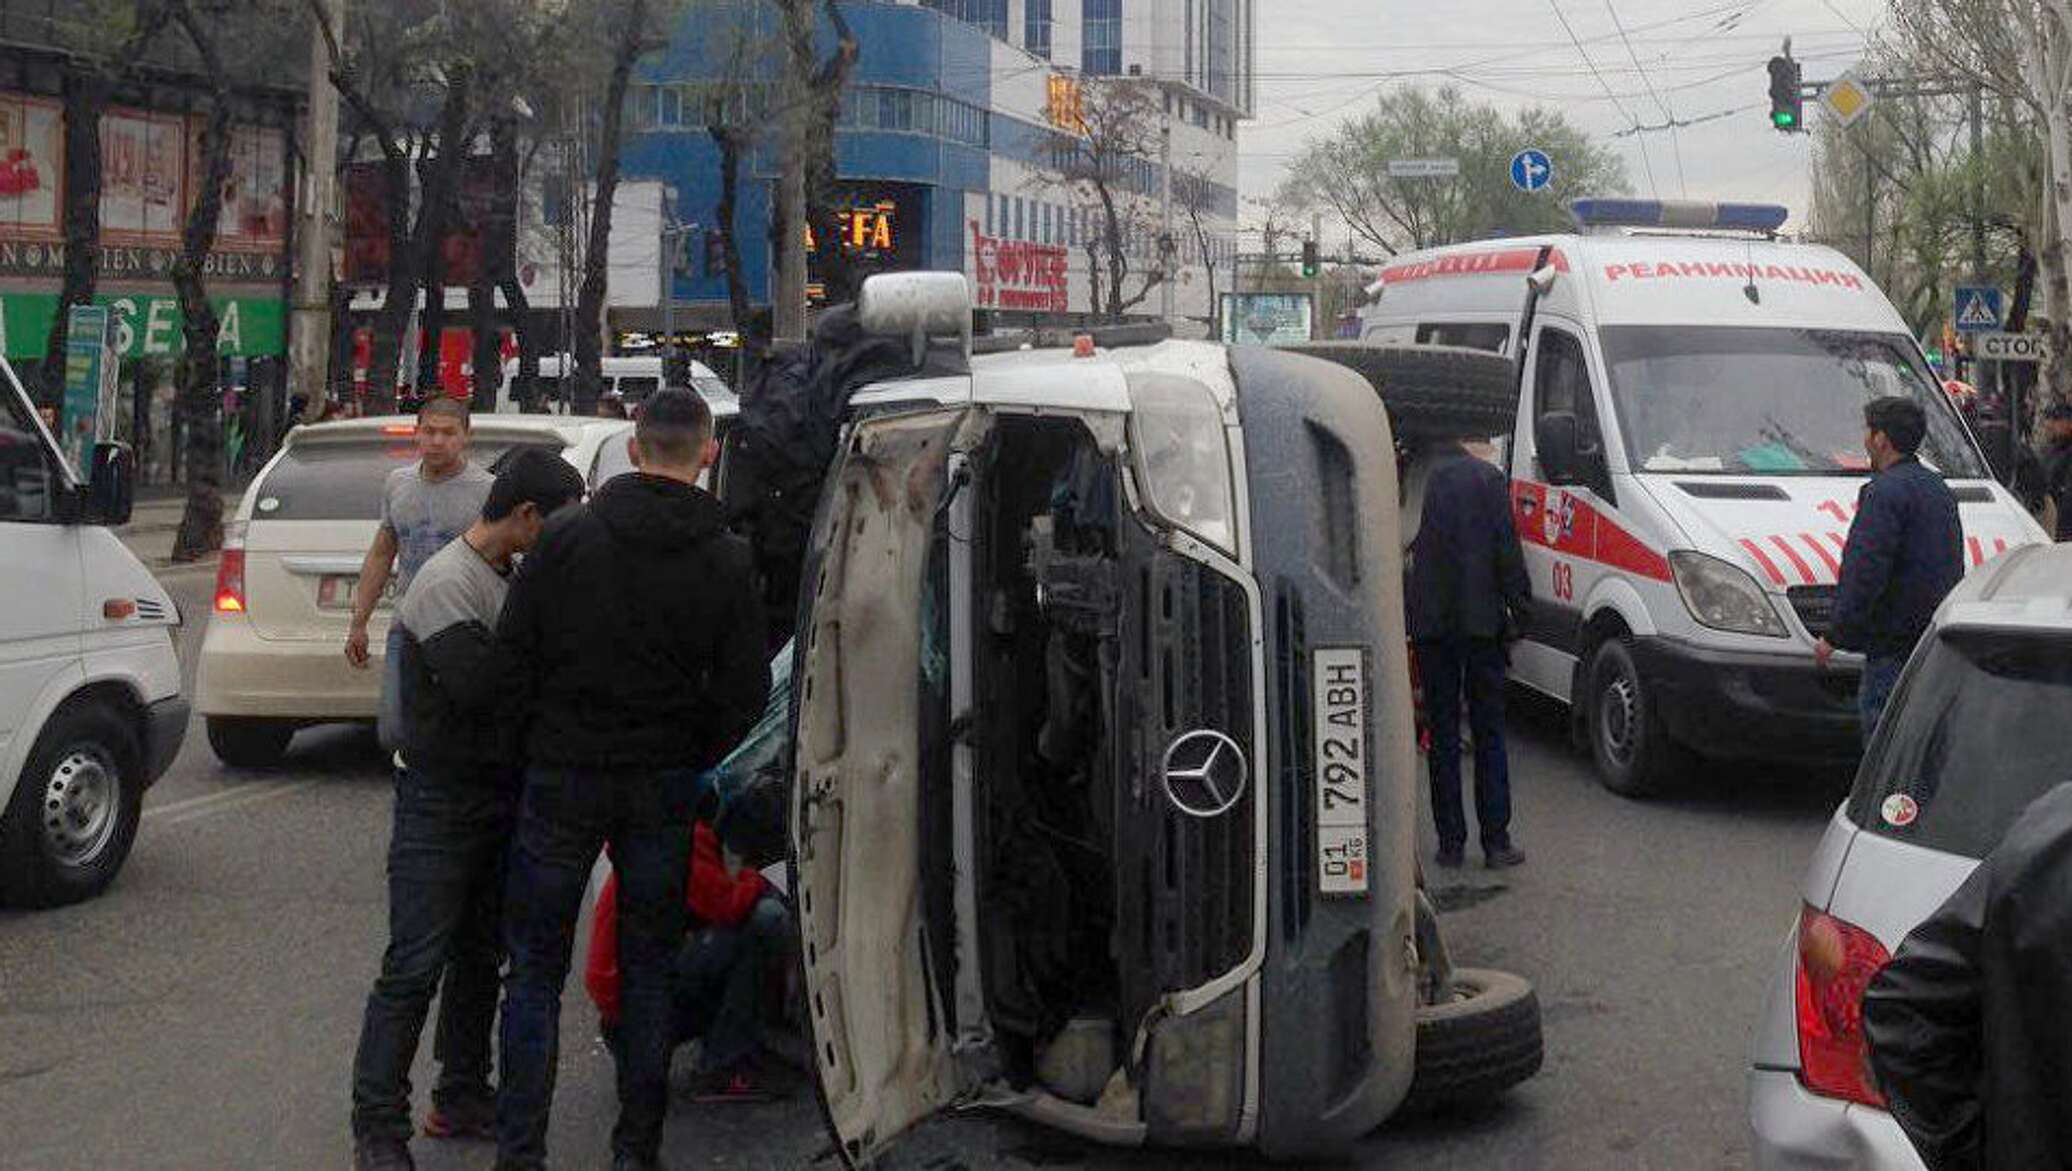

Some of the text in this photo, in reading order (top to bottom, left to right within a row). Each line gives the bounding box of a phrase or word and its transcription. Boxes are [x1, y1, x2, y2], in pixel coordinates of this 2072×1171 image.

[1604, 261, 1864, 291] РЕАНИМАЦИЯ
[1552, 561, 1573, 601] 03
[1323, 738, 1360, 812] 792
[1324, 844, 1348, 876] 01
